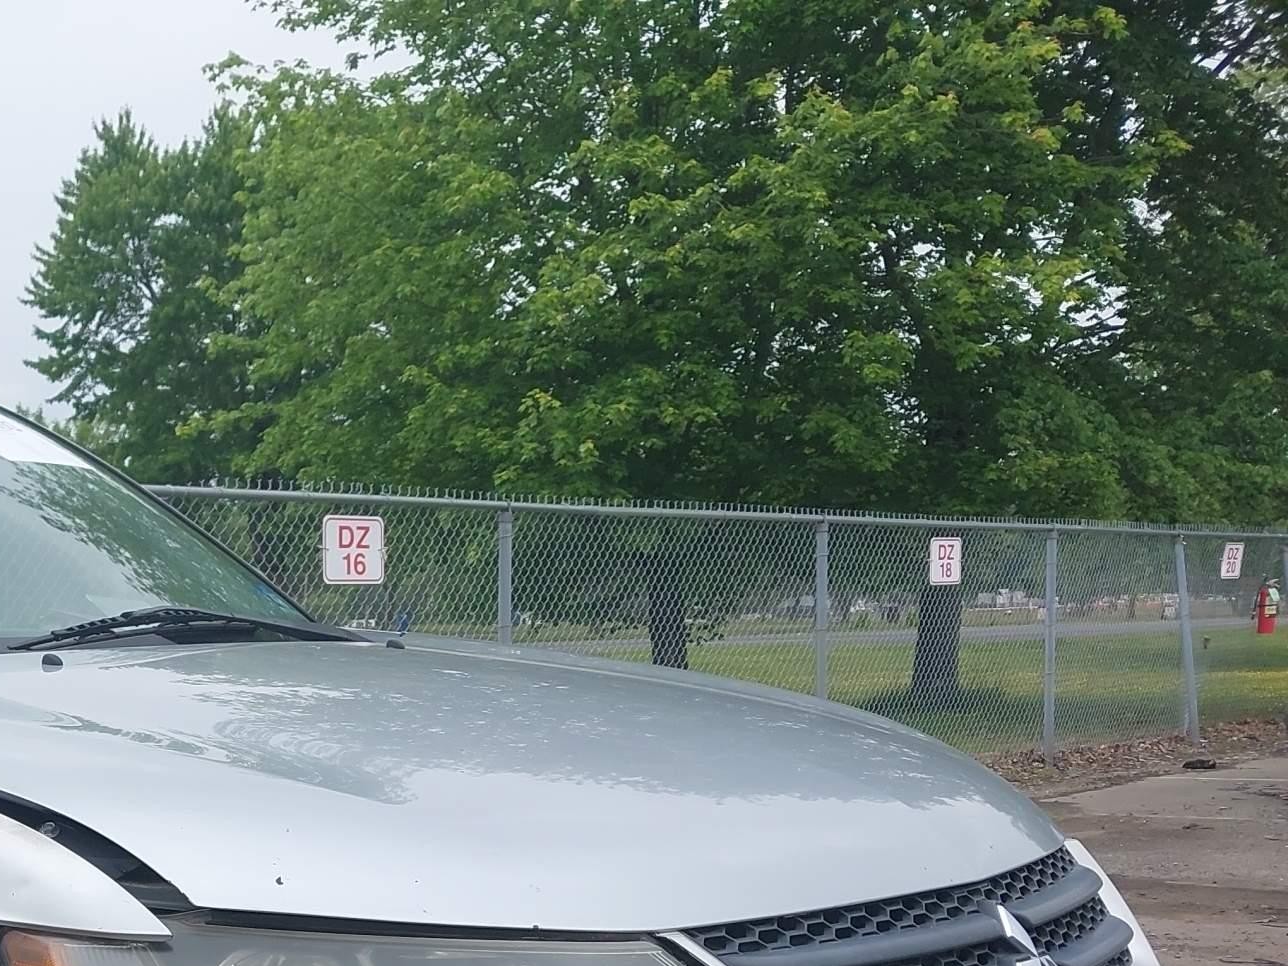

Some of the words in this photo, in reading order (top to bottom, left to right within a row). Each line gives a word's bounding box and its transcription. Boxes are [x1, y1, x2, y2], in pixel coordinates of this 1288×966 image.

[338, 525, 370, 549] DZ
[938, 544, 955, 560] DZ
[1227, 547, 1240, 560] DZ
[342, 553, 366, 575] 16
[939, 562, 952, 578] 18
[1226, 561, 1237, 573] 20
